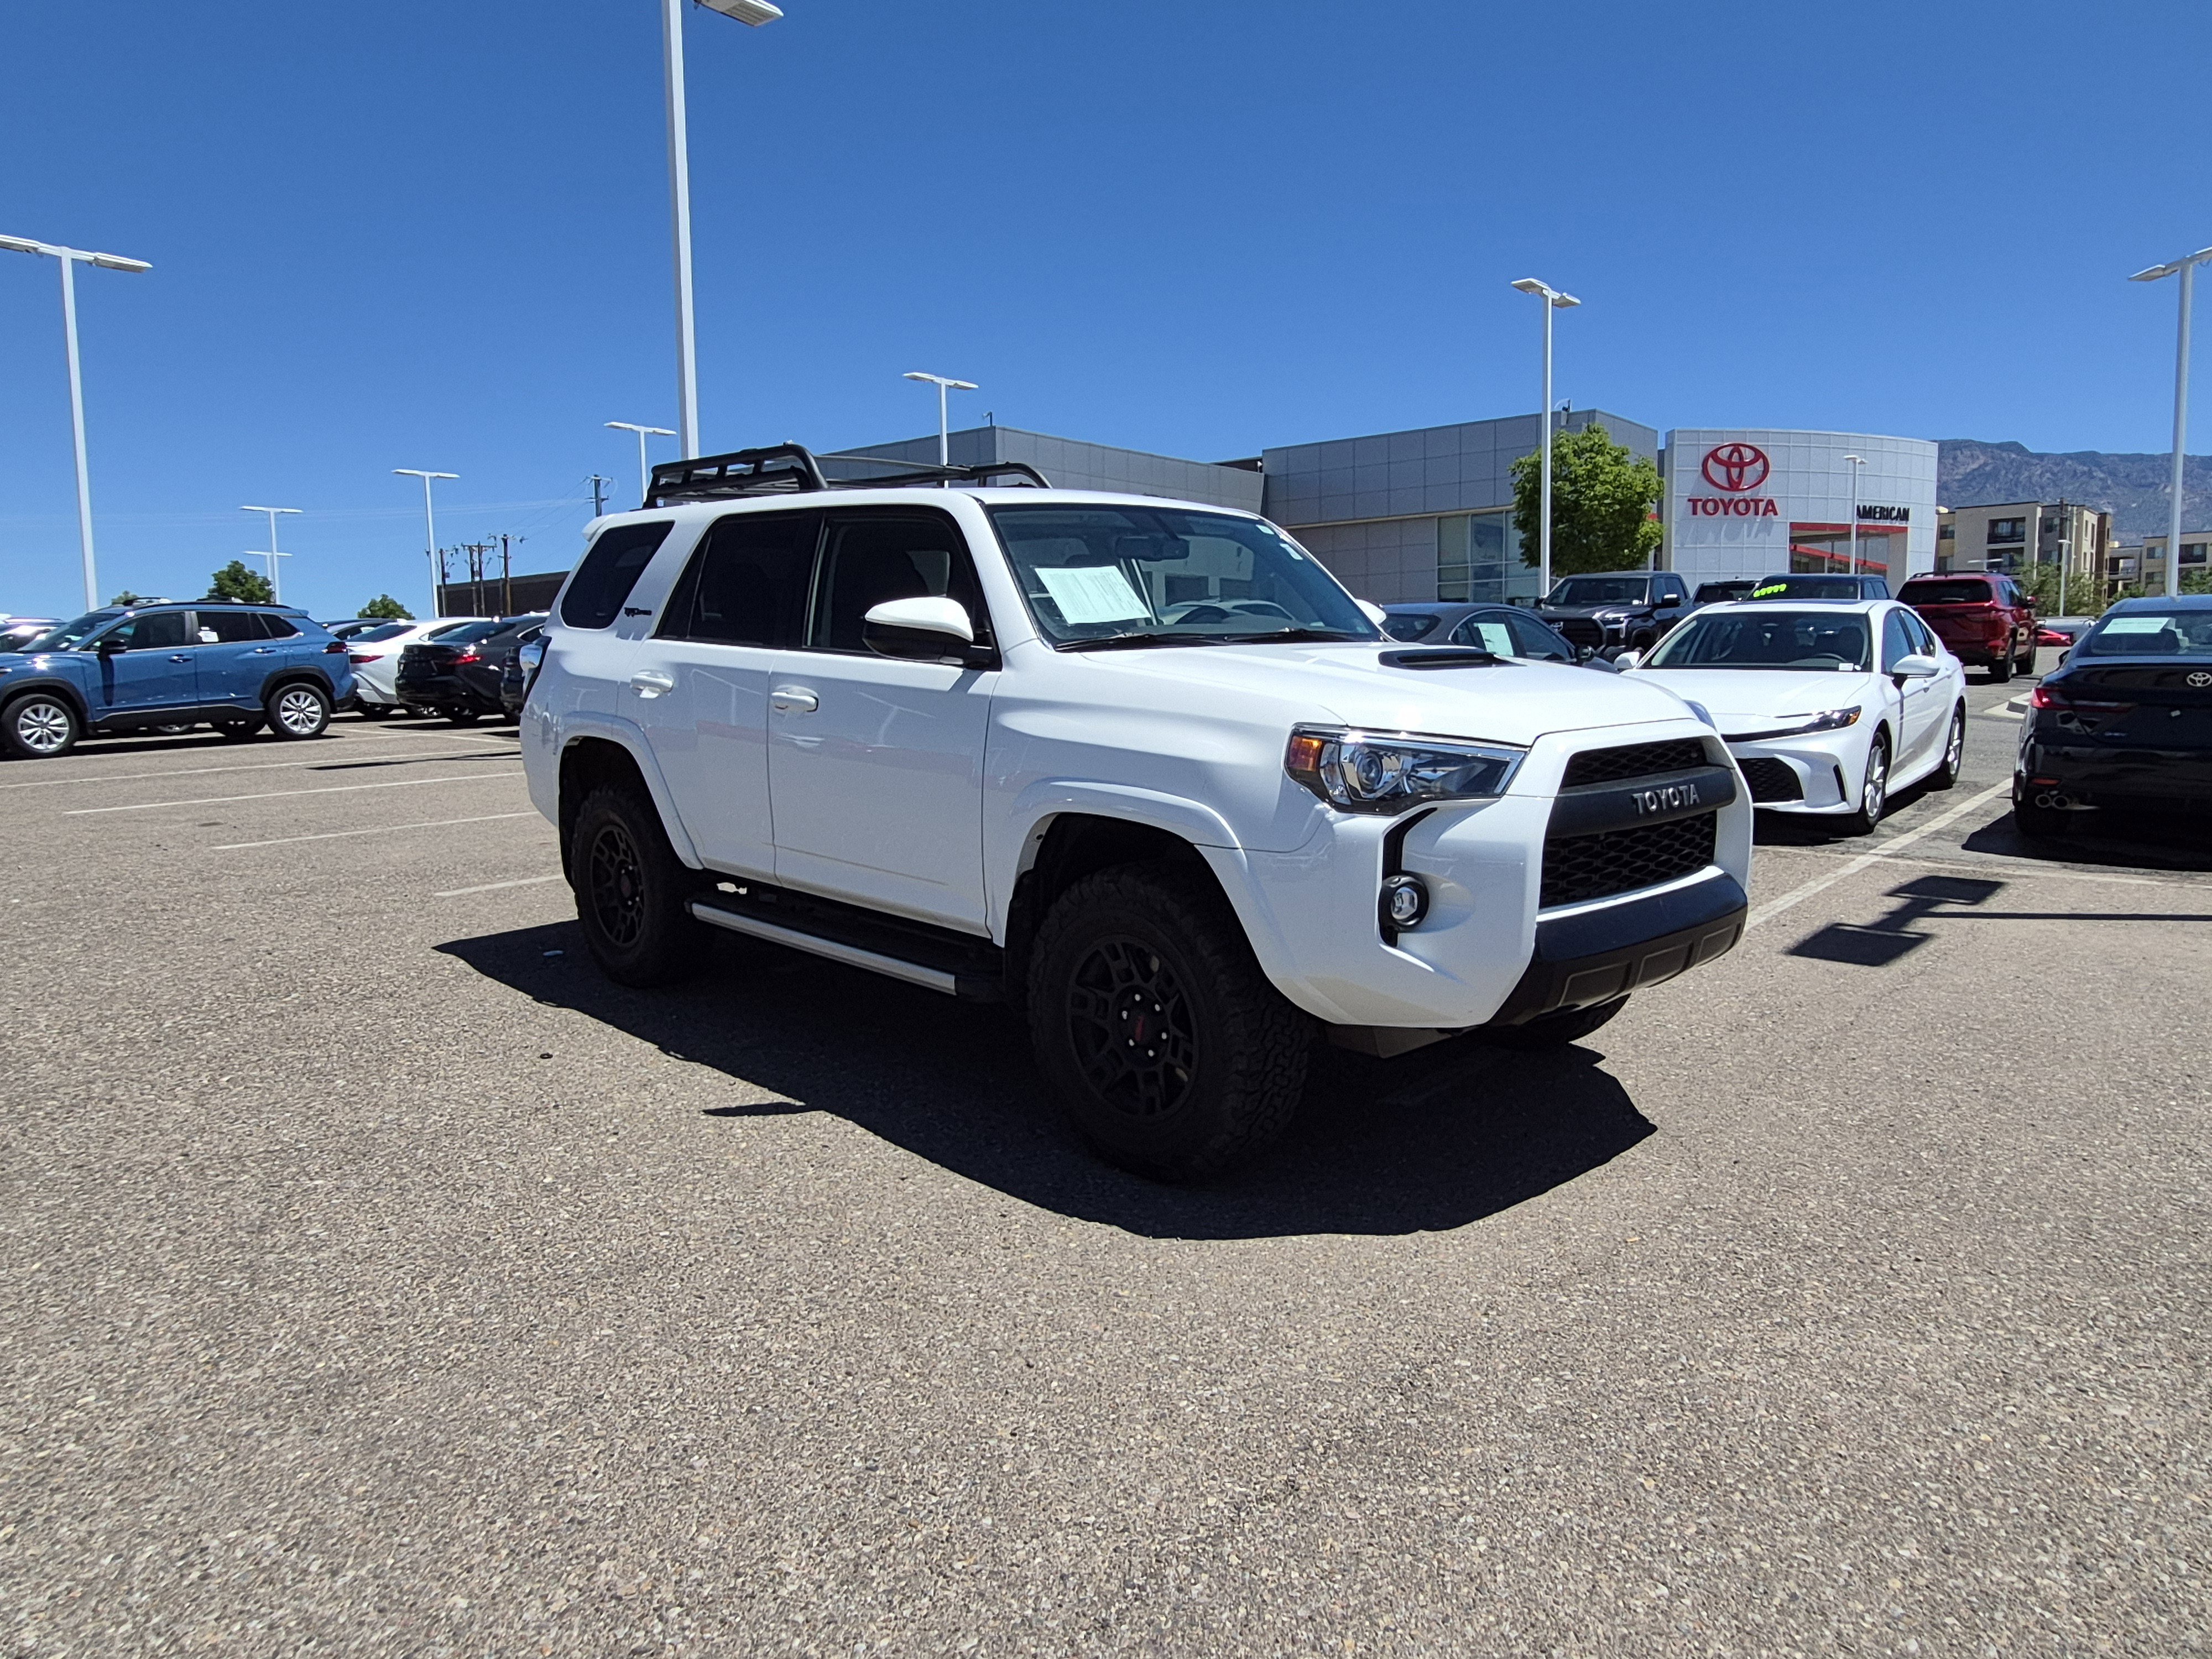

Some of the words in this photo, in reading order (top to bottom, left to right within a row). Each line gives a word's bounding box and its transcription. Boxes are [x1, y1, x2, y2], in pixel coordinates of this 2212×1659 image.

[1688, 498, 1779, 517] TOYOTA
[1856, 505, 1910, 521] AMERICAN
[1632, 784, 1700, 815] TOYOTA
